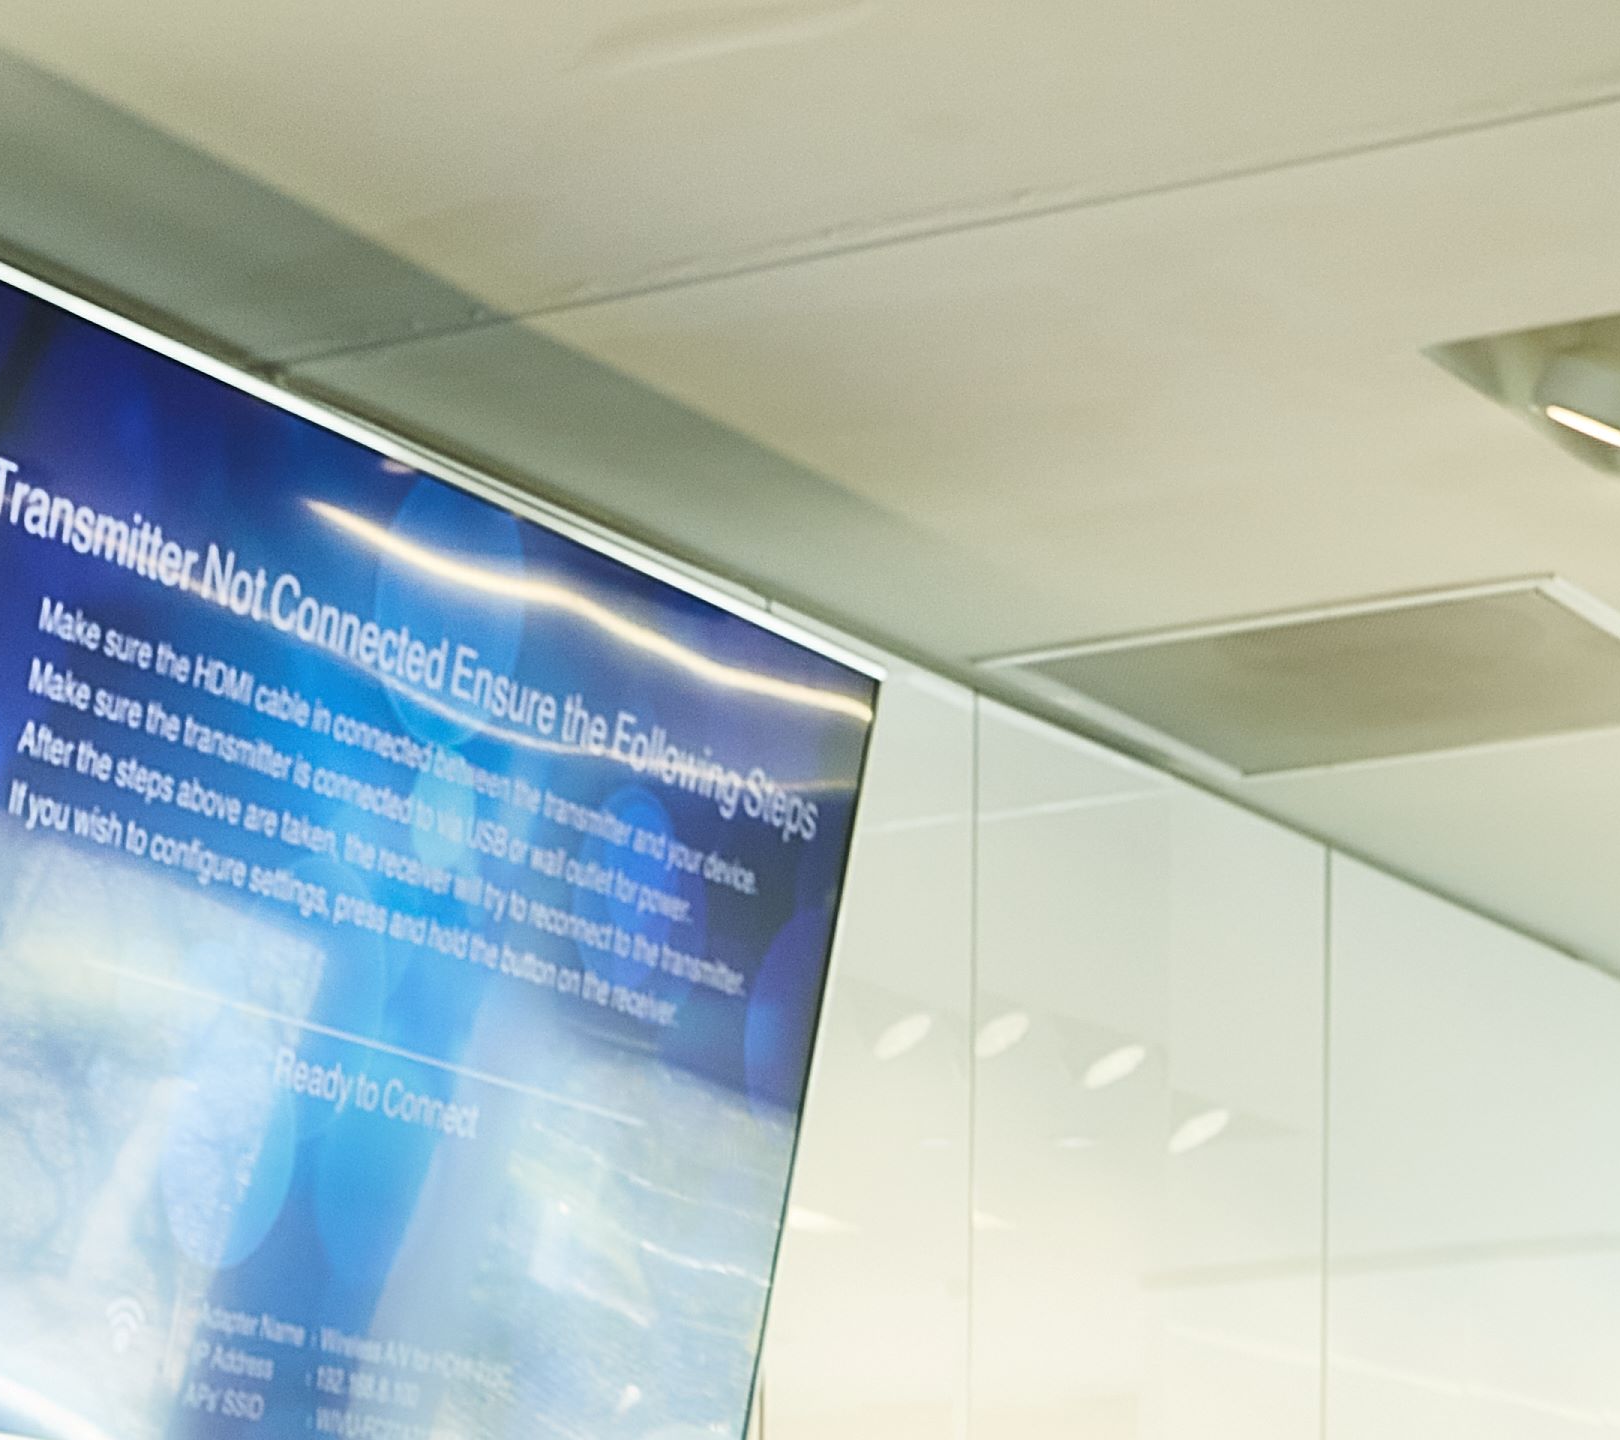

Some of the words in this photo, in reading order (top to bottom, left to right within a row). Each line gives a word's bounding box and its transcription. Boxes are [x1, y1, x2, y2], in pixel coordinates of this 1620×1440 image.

[28, 659, 92, 709] Make
[93, 683, 144, 728] sure
[145, 702, 181, 741] the
[183, 716, 291, 780] transmitter
[292, 756, 312, 788] is
[312, 763, 413, 824] connected
[415, 801, 434, 831] to
[470, 821, 508, 858] USB
[508, 835, 528, 865] or
[529, 842, 565, 878] wall
[565, 856, 613, 895] outlet
[613, 873, 638, 904] for
[38, 598, 101, 649] Make
[103, 623, 154, 668] sure
[154, 643, 191, 682] the
[193, 658, 254, 706] HDMI
[254, 681, 310, 727] cable
[311, 703, 332, 735] in
[332, 711, 432, 773] connected
[432, 749, 510, 802] between
[513, 780, 541, 813] the
[542, 791, 632, 847] transmitter
[633, 826, 666, 860] and
[664, 838, 703, 881] your
[702, 853, 760, 895] device.
[199, 542, 269, 621] Not
[271, 571, 445, 692] Connected
[453, 645, 556, 735] Ensure
[559, 690, 610, 755] the
[612, 714, 739, 818] Following
[739, 767, 821, 850] Steps
[8, 782, 26, 815] If
[25, 788, 71, 837] you
[73, 804, 124, 847] wish
[124, 821, 148, 855] to
[148, 829, 246, 893] configure
[247, 862, 331, 921] settings,
[332, 890, 389, 939] press
[388, 908, 427, 945] and
[427, 921, 469, 958] hold
[468, 935, 499, 968] the
[500, 946, 557, 987] button
[557, 964, 582, 995] on
[580, 972, 610, 1004] the
[18, 720, 74, 768] After
[75, 741, 112, 781] the
[113, 754, 175, 810] steps
[177, 776, 242, 826] above
[243, 799, 278, 838] are
[279, 812, 343, 866] taken,
[342, 834, 376, 871] the
[376, 845, 452, 897] receiver
[453, 872, 482, 907] will
[481, 883, 509, 922] try
[508, 891, 527, 922] to
[527, 898, 612, 951] reconnect
[612, 928, 633, 958] to
[632, 935, 660, 967] the
[271, 1048, 352, 1112] Ready
[354, 1075, 381, 1111] to
[382, 1079, 481, 1140] Connect
